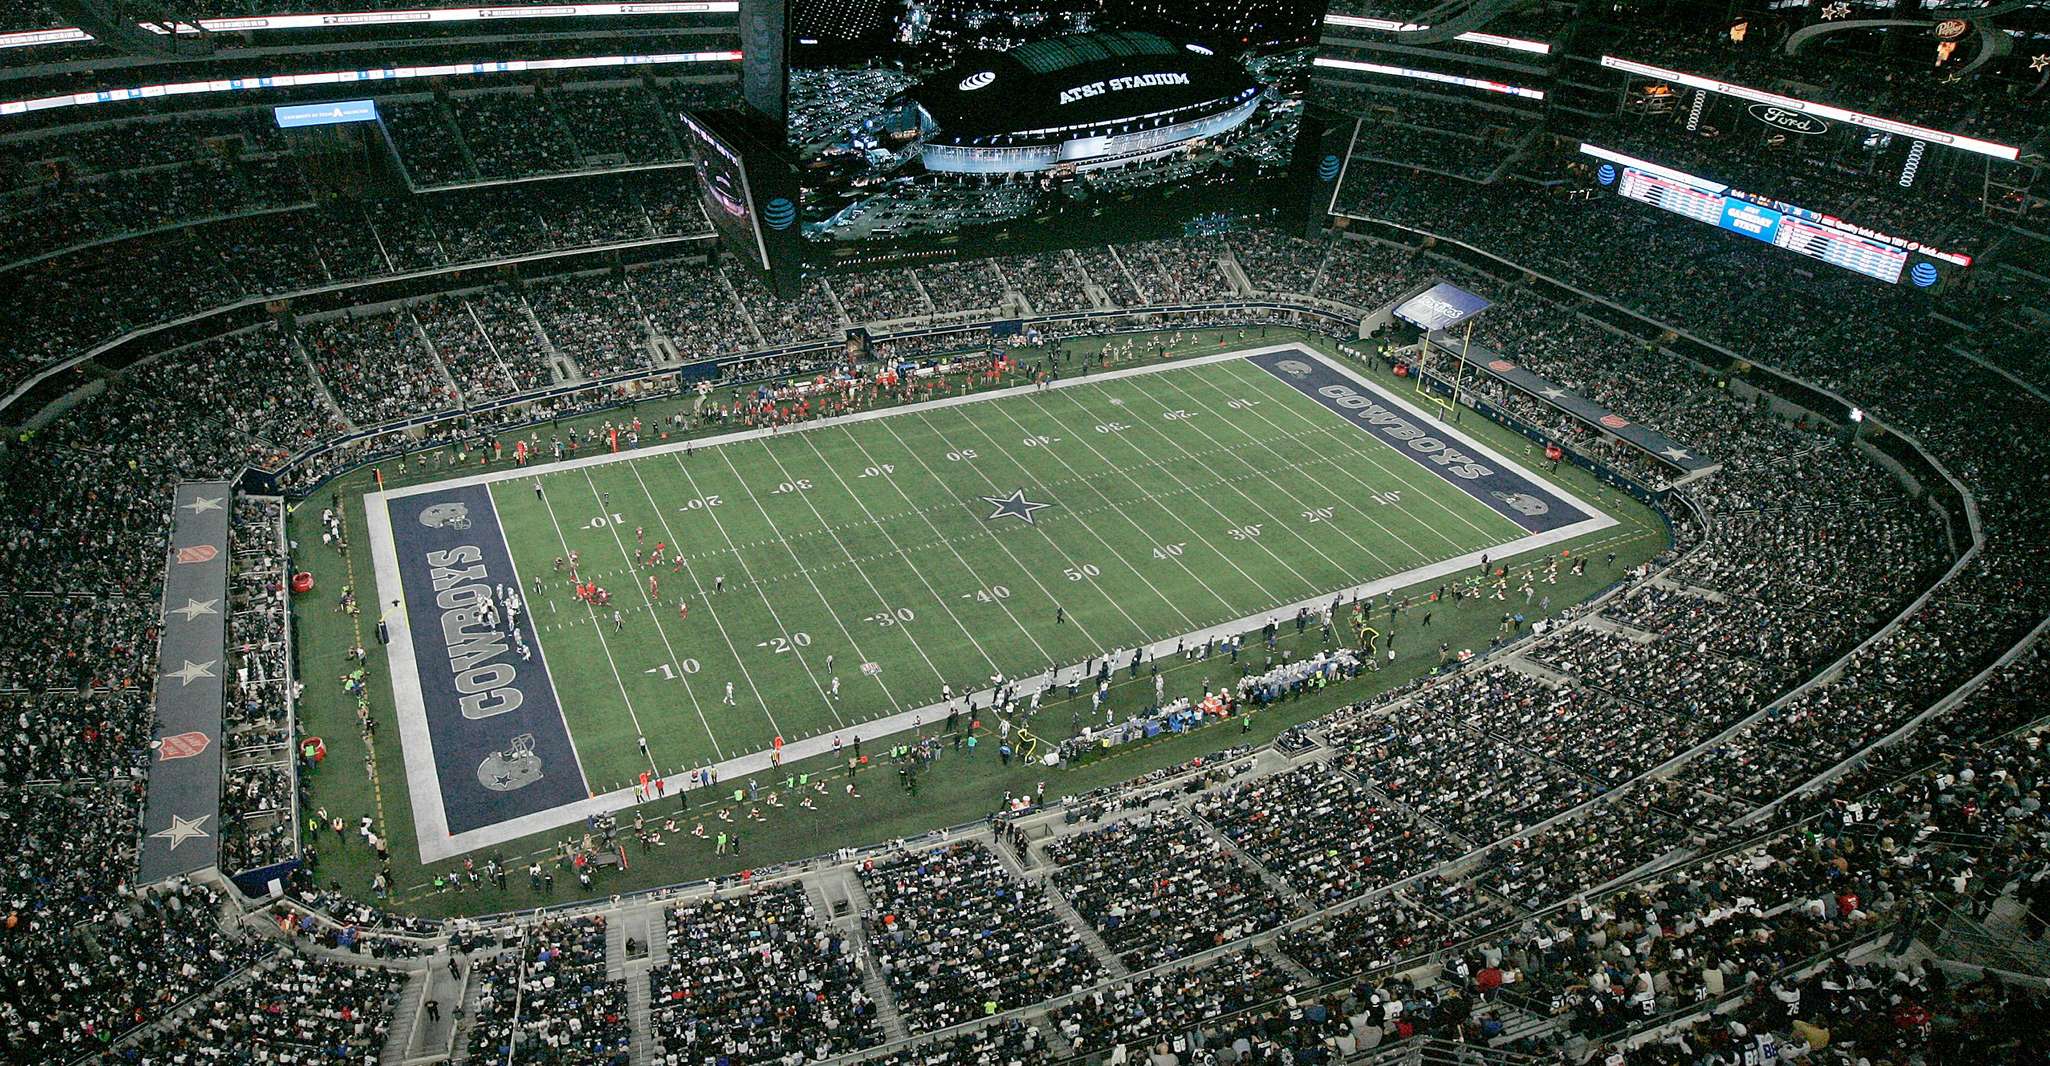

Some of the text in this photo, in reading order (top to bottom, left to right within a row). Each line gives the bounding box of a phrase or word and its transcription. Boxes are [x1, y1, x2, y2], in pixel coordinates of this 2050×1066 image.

[1060, 72, 1190, 105] AT&T STADIUM
[1764, 107, 1812, 131] Ford
[1318, 385, 1495, 480] COWBOYS
[426, 545, 524, 720] COWBOYS
